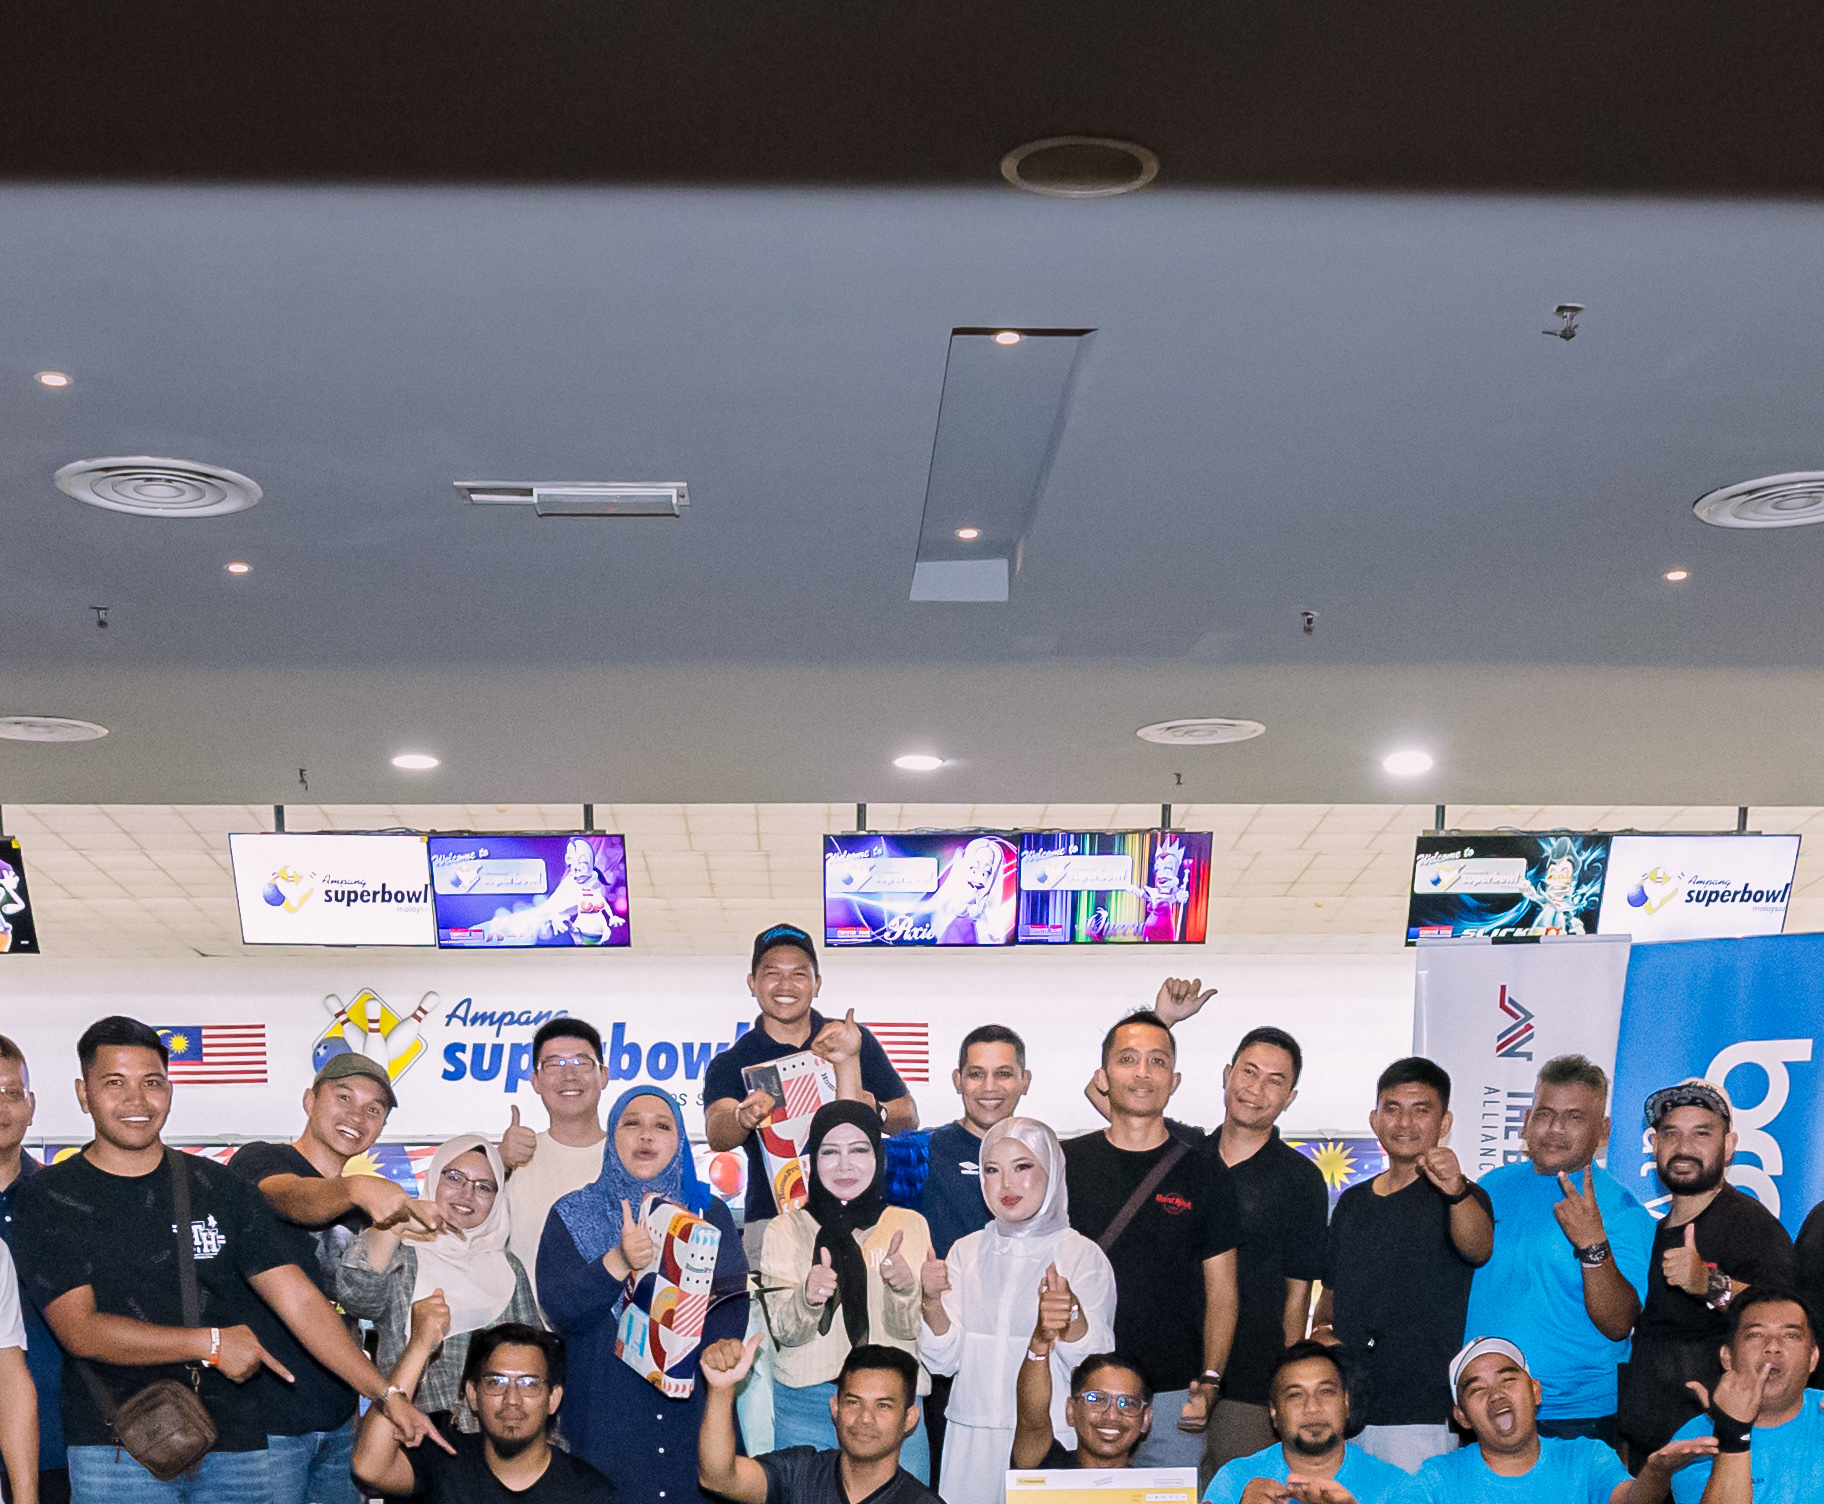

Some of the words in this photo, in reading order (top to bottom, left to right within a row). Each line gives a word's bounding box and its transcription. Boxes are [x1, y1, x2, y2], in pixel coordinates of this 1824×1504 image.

[322, 875, 366, 887] Ampang
[1687, 876, 1731, 888] Ampang
[324, 883, 429, 907] superbowl
[1685, 883, 1790, 907] superbowl
[397, 905, 430, 914] malays
[445, 998, 568, 1037] Ampan
[441, 1022, 751, 1093] supbow
[1479, 1086, 1501, 1172] ALLIANC
